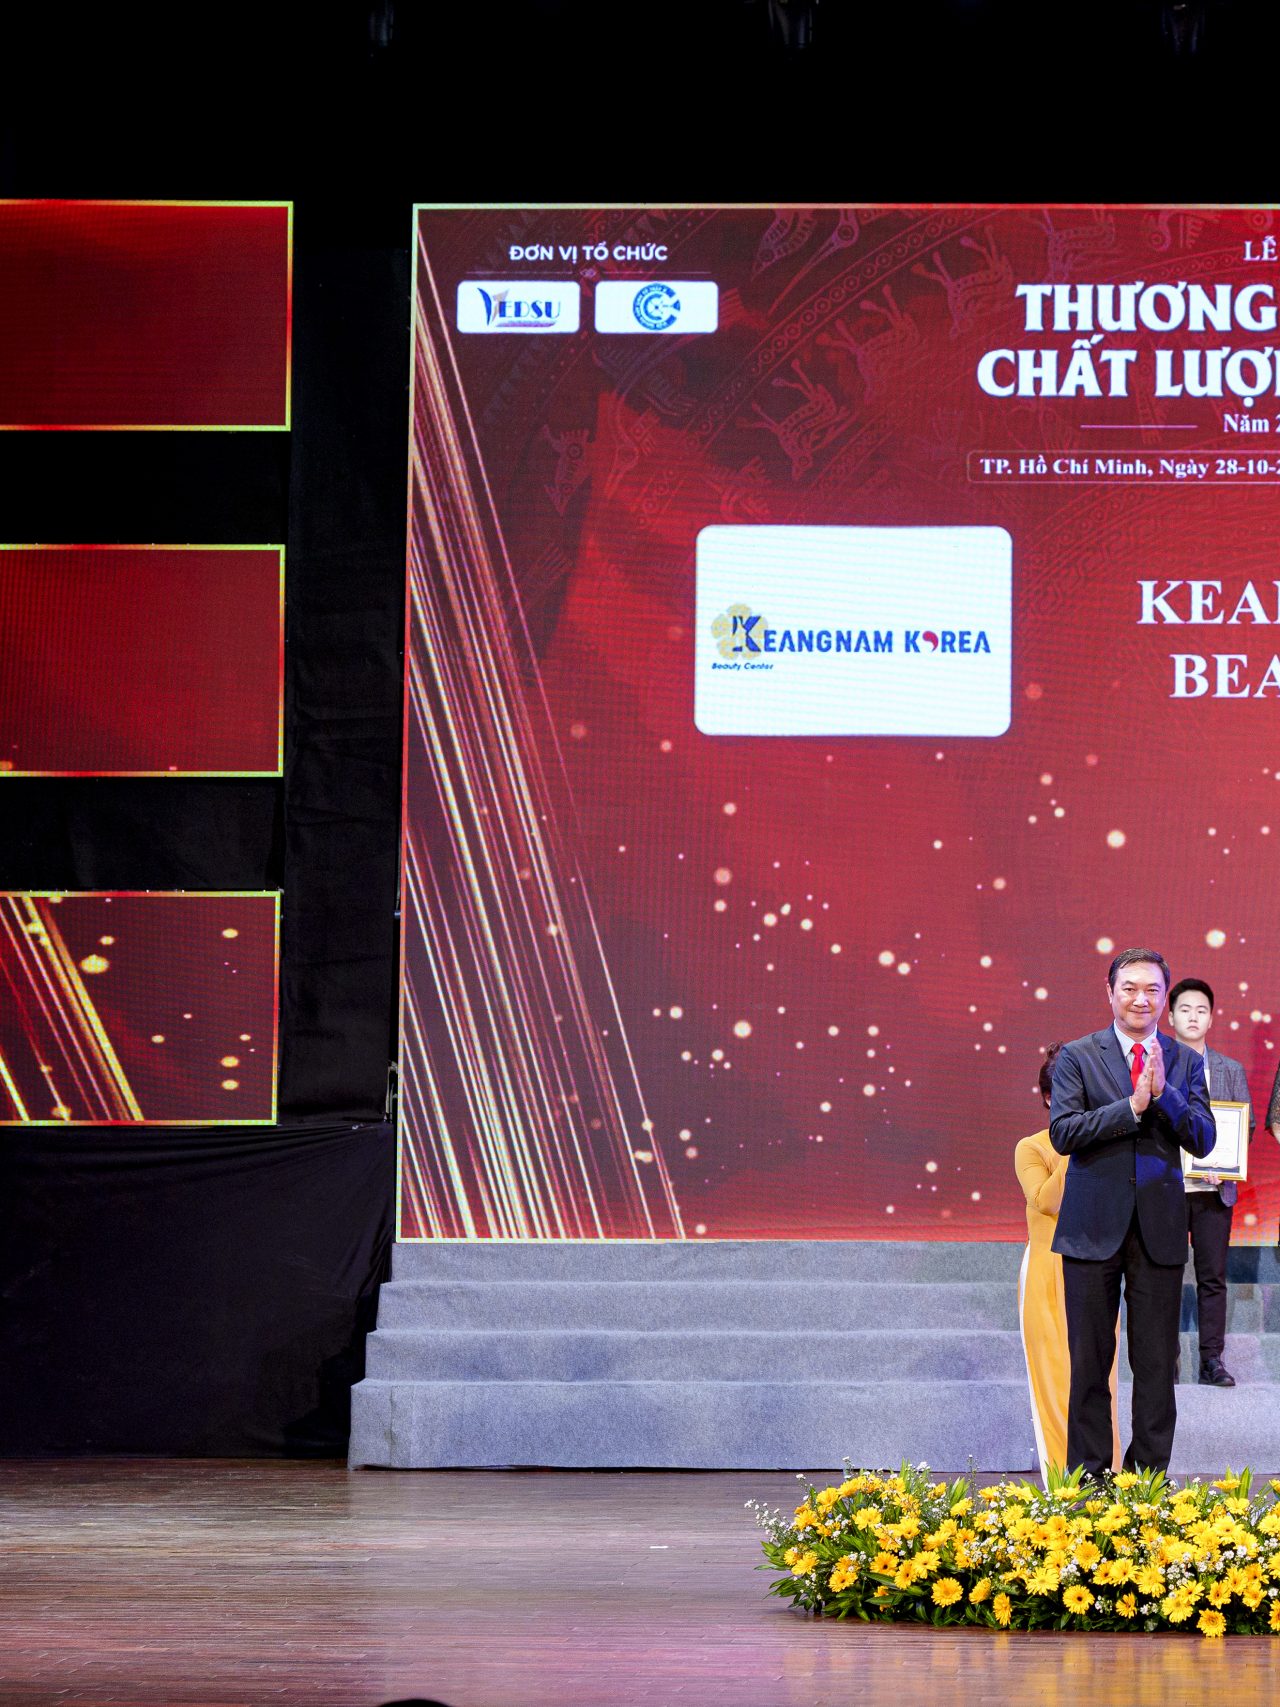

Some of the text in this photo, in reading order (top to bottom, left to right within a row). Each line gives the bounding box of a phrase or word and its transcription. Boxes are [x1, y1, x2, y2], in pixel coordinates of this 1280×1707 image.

[509, 243, 553, 261] ĐƠN
[559, 246, 577, 265] VỊ
[613, 243, 668, 261] CHỨC
[1243, 235, 1278, 261] LỄ
[1015, 281, 1277, 332] THƯƠNG
[977, 334, 1137, 397] CHẤT
[1223, 413, 1270, 433] Năm
[980, 458, 1012, 475] TP.
[1019, 455, 1047, 475] Hồ
[1053, 458, 1089, 475] Chí
[1095, 458, 1154, 477] Minh,
[1159, 458, 1209, 478] Ngày
[732, 615, 893, 653] KEANGNAM
